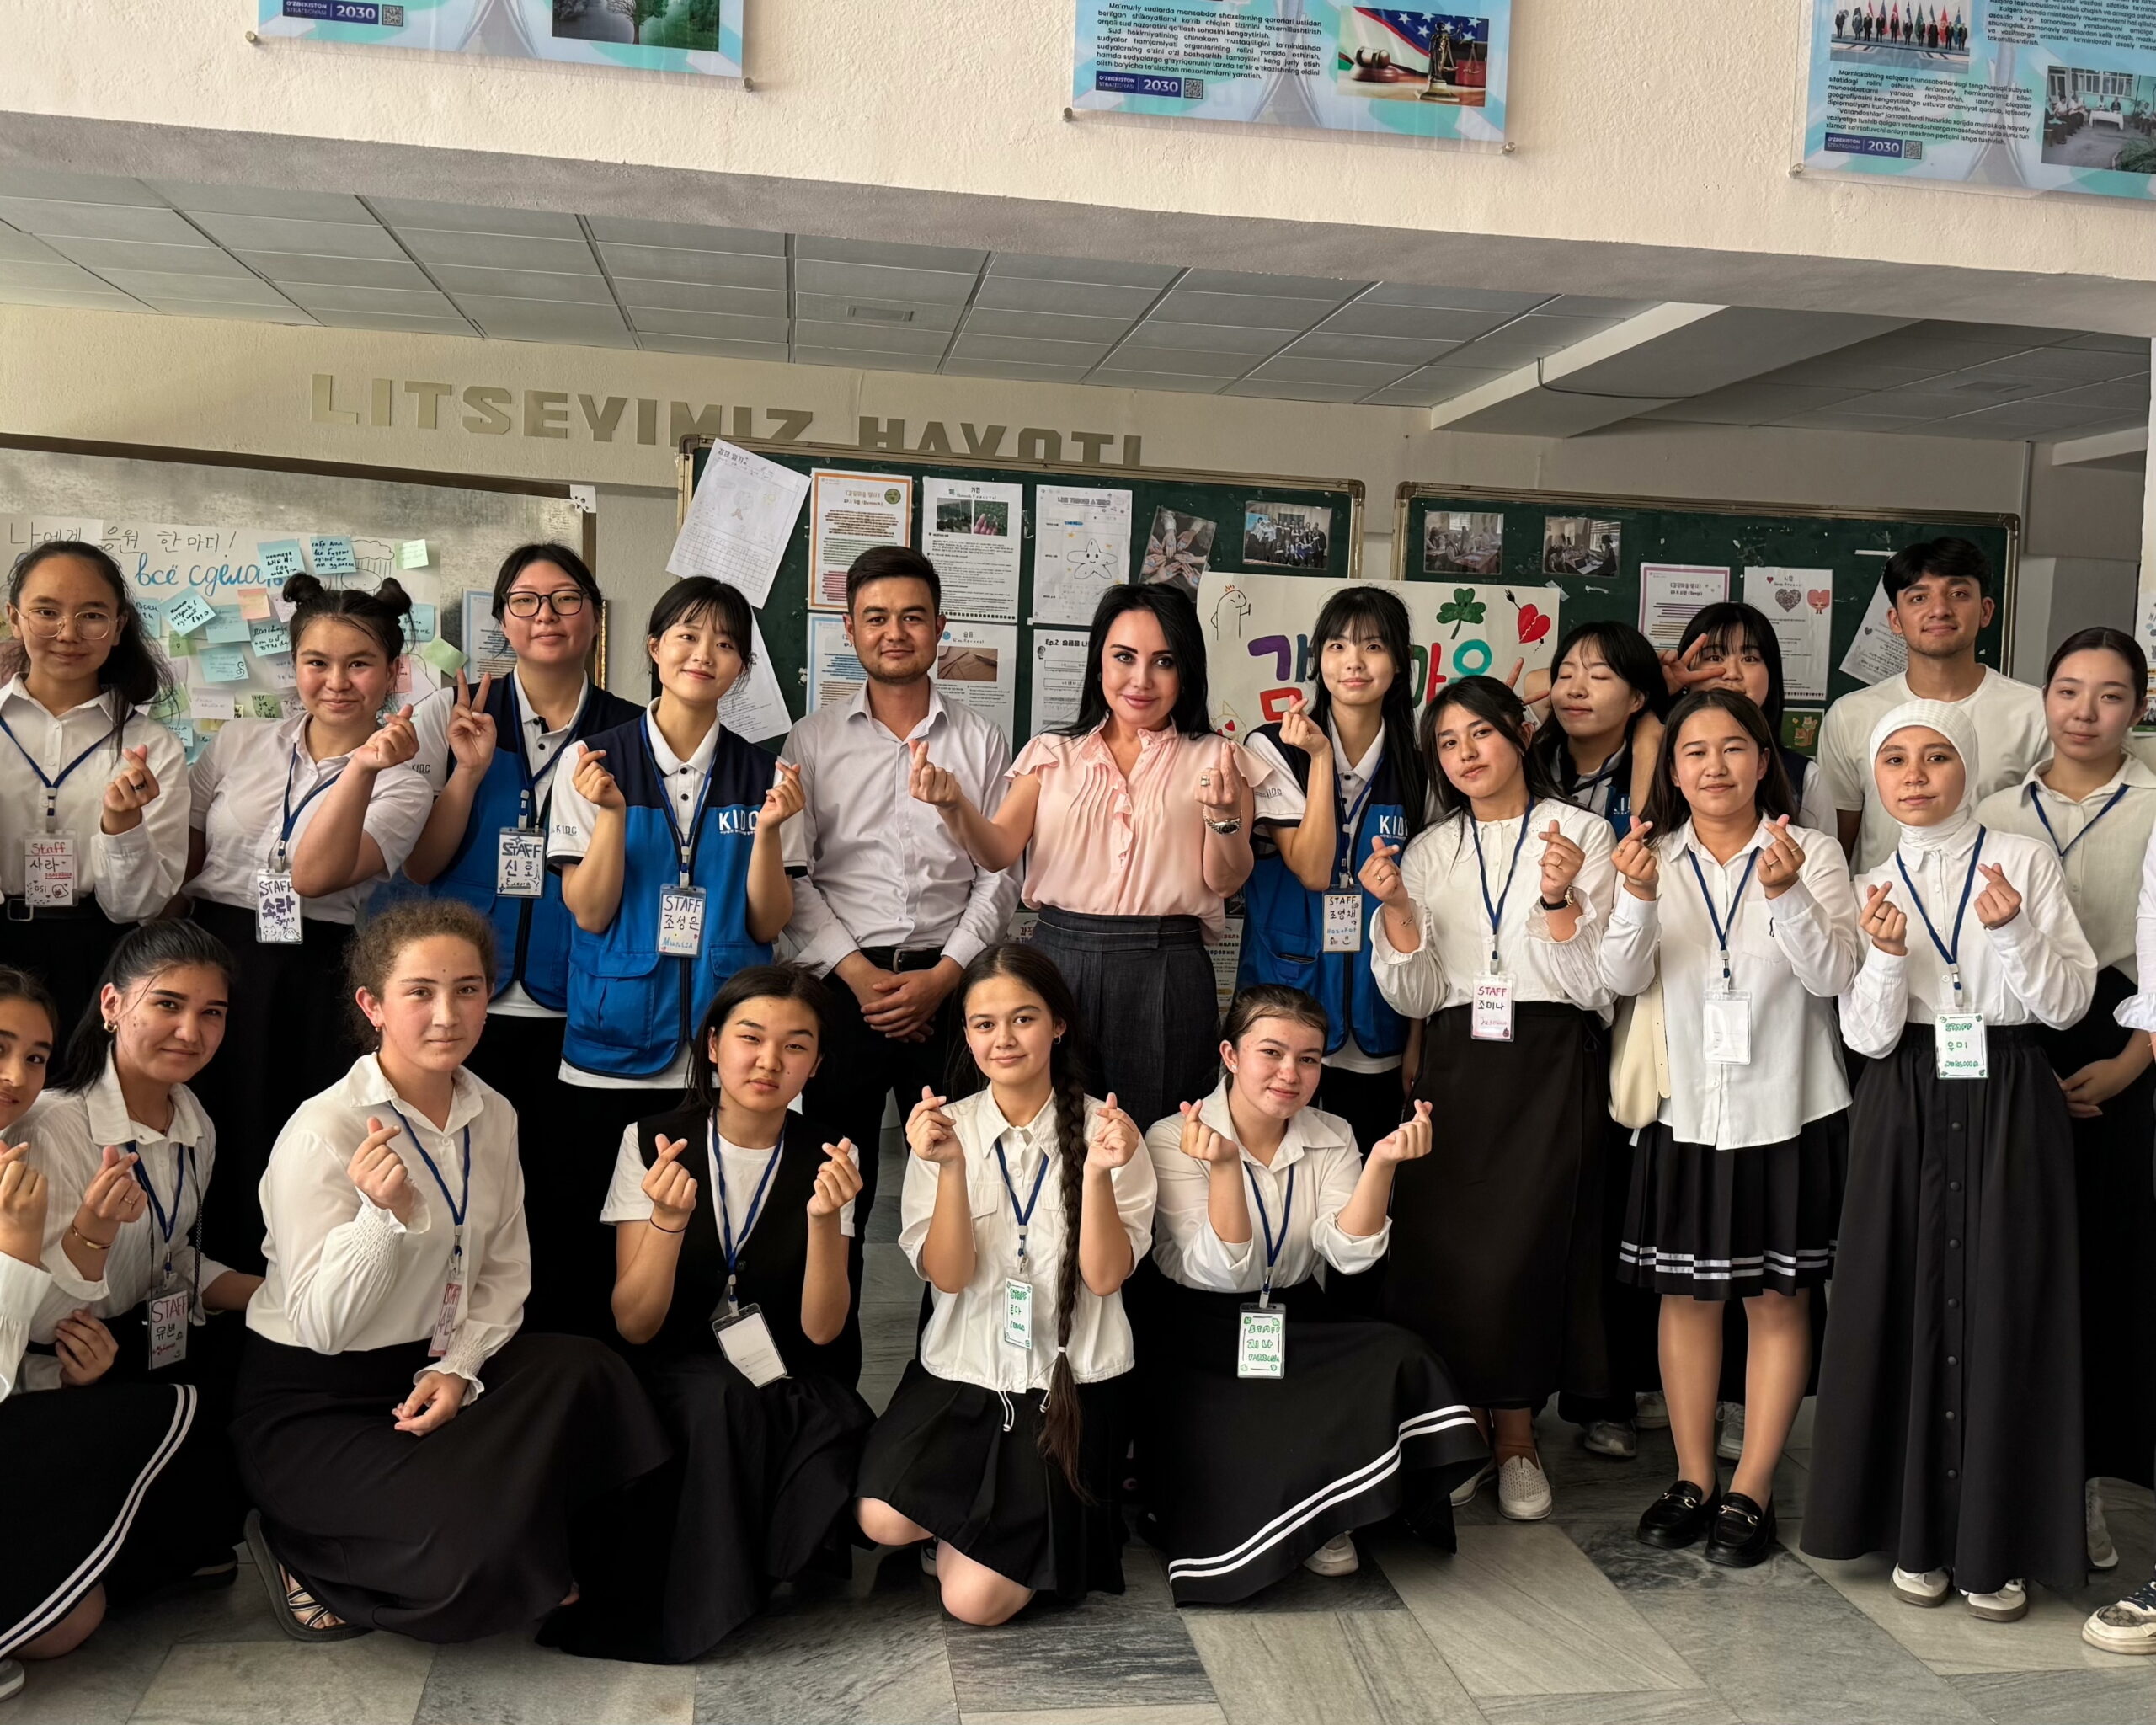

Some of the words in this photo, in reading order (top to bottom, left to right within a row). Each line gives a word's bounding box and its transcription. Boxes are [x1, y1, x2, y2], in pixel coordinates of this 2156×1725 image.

[336, 5, 376, 19] 2030
[1143, 78, 1178, 93] 2030
[1867, 140, 1899, 153] 2030
[312, 374, 814, 446] LITSEYIMIZ
[157, 531, 179, 553] 한
[135, 553, 179, 586] всё
[31, 842, 66, 855] Staff
[502, 842, 542, 858] STAFF
[262, 895, 296, 920] 소라
[664, 895, 702, 913] STAFF
[1329, 896, 1357, 906] STAFF
[664, 914, 700, 931] 조성은
[1477, 986, 1508, 997] STAFF
[1477, 1000, 1505, 1010] 조미나
